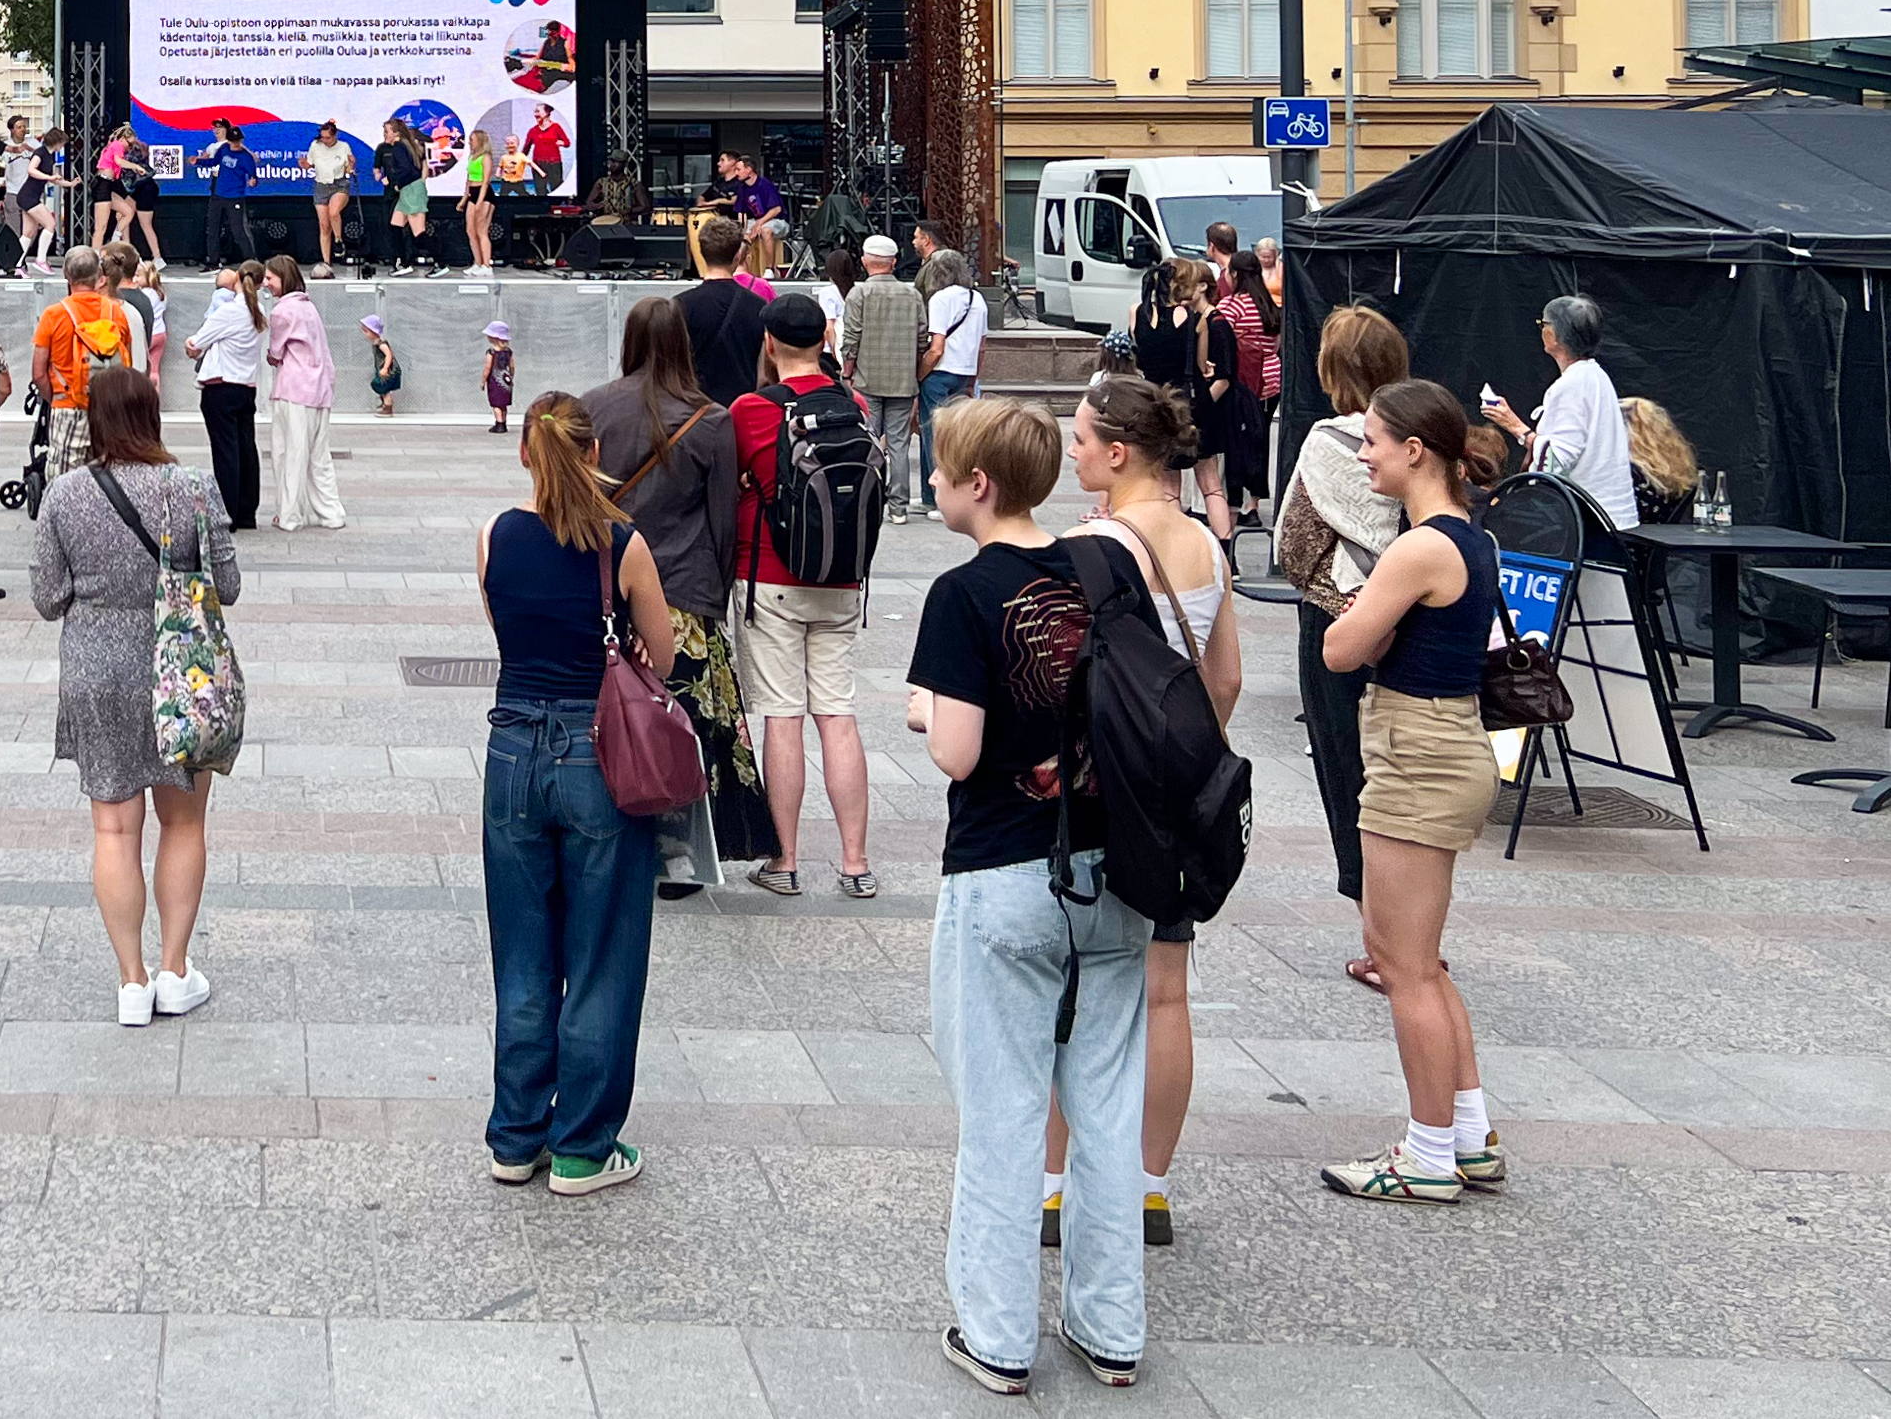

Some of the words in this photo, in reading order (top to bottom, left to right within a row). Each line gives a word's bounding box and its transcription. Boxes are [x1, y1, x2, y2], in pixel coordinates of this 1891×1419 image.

[159, 17, 182, 28] Tule
[184, 17, 261, 30] Oulu-opistoon
[264, 18, 317, 30] oppimaan
[321, 17, 381, 28] mukavassa
[383, 17, 440, 29] porukassa
[442, 17, 490, 29] vaikkapa
[369, 32, 417, 41] teatteria
[420, 31, 434, 41] tai
[159, 46, 209, 58] Opetusta
[210, 46, 275, 59] järjestetään
[278, 46, 293, 56] eri
[295, 46, 335, 58] puolilla
[337, 46, 367, 56] Oulua
[369, 46, 380, 58] ja
[254, 77, 268, 86] on
[270, 76, 296, 86] vielä
[298, 75, 322, 86] tilaa
[333, 76, 373, 87] nappaa
[376, 75, 421, 87] paikkasi
[423, 75, 445, 88] nyt!
[1524, 573, 1560, 602] ICE
